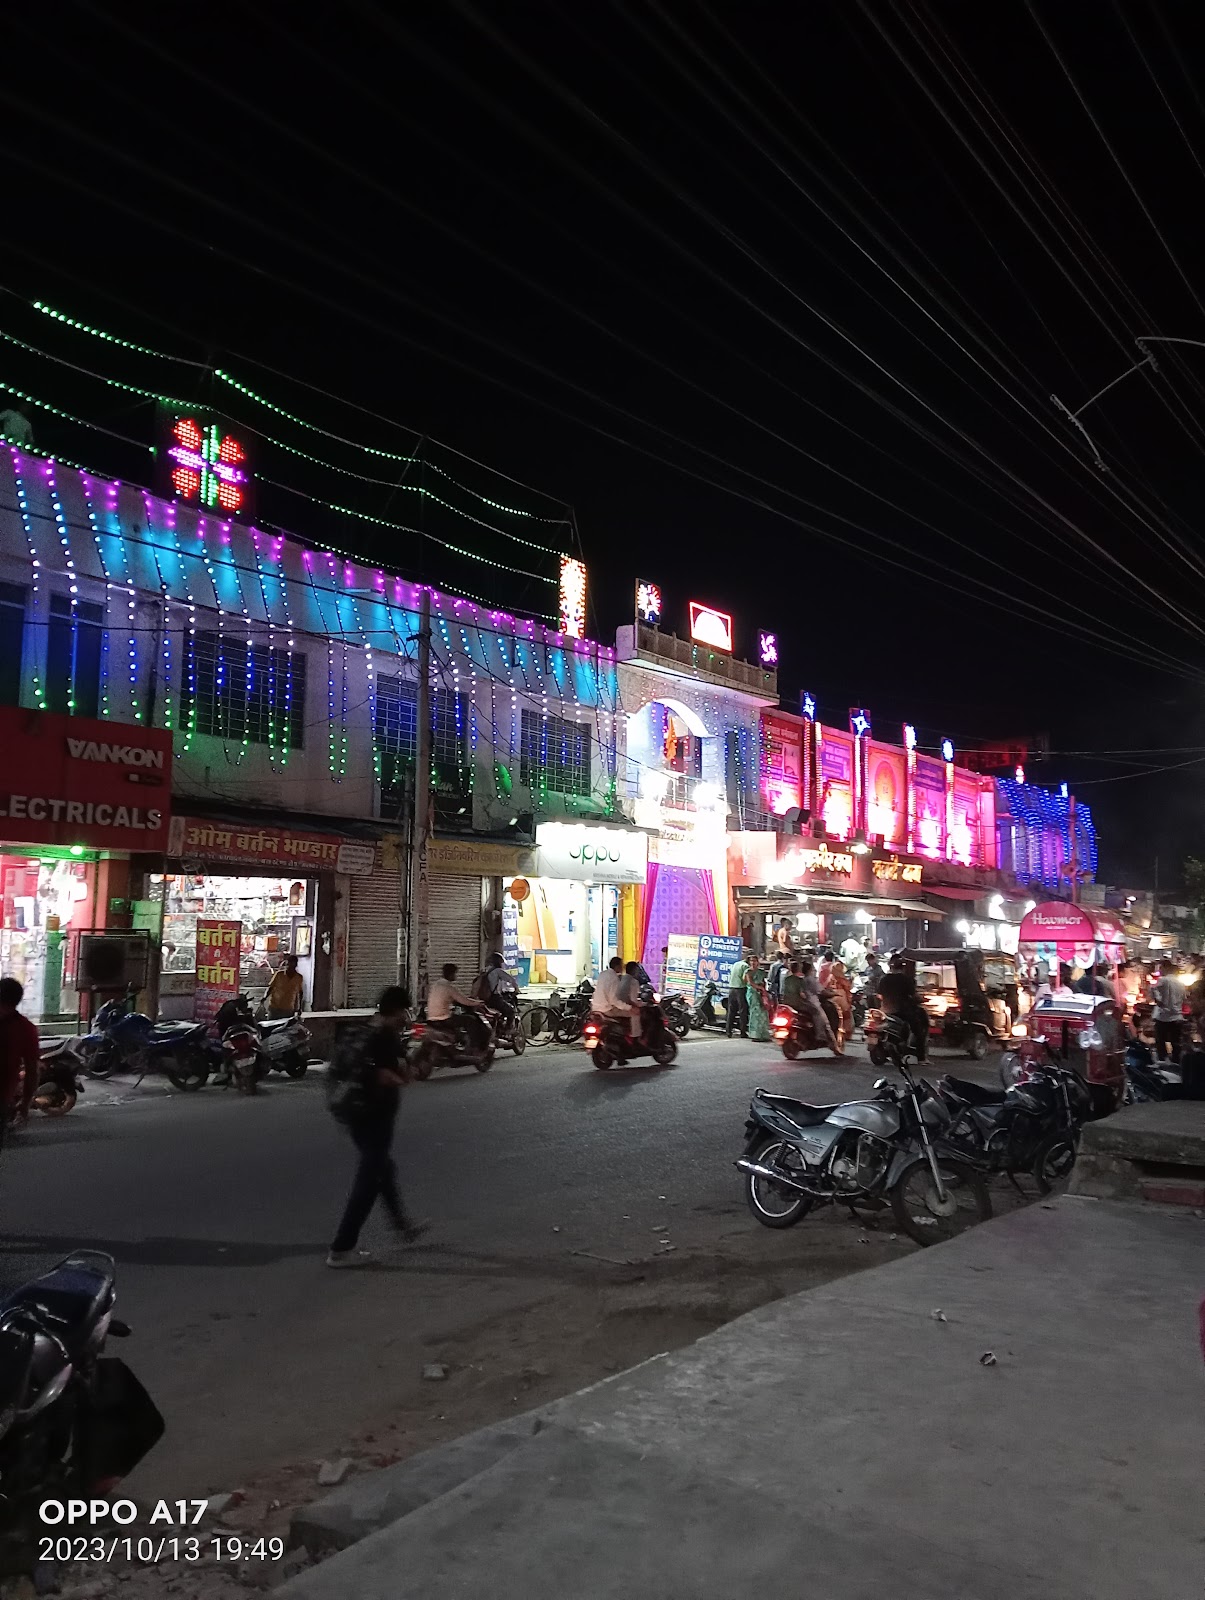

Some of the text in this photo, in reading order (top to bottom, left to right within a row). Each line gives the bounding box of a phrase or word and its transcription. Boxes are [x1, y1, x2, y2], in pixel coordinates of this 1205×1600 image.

[236, 830, 280, 854] बर्तन
[1030, 913, 1083, 925] Havmor
[198, 923, 237, 947] बर्तन
[712, 937, 740, 945] BAJAJ
[197, 960, 236, 985] बर्तन
